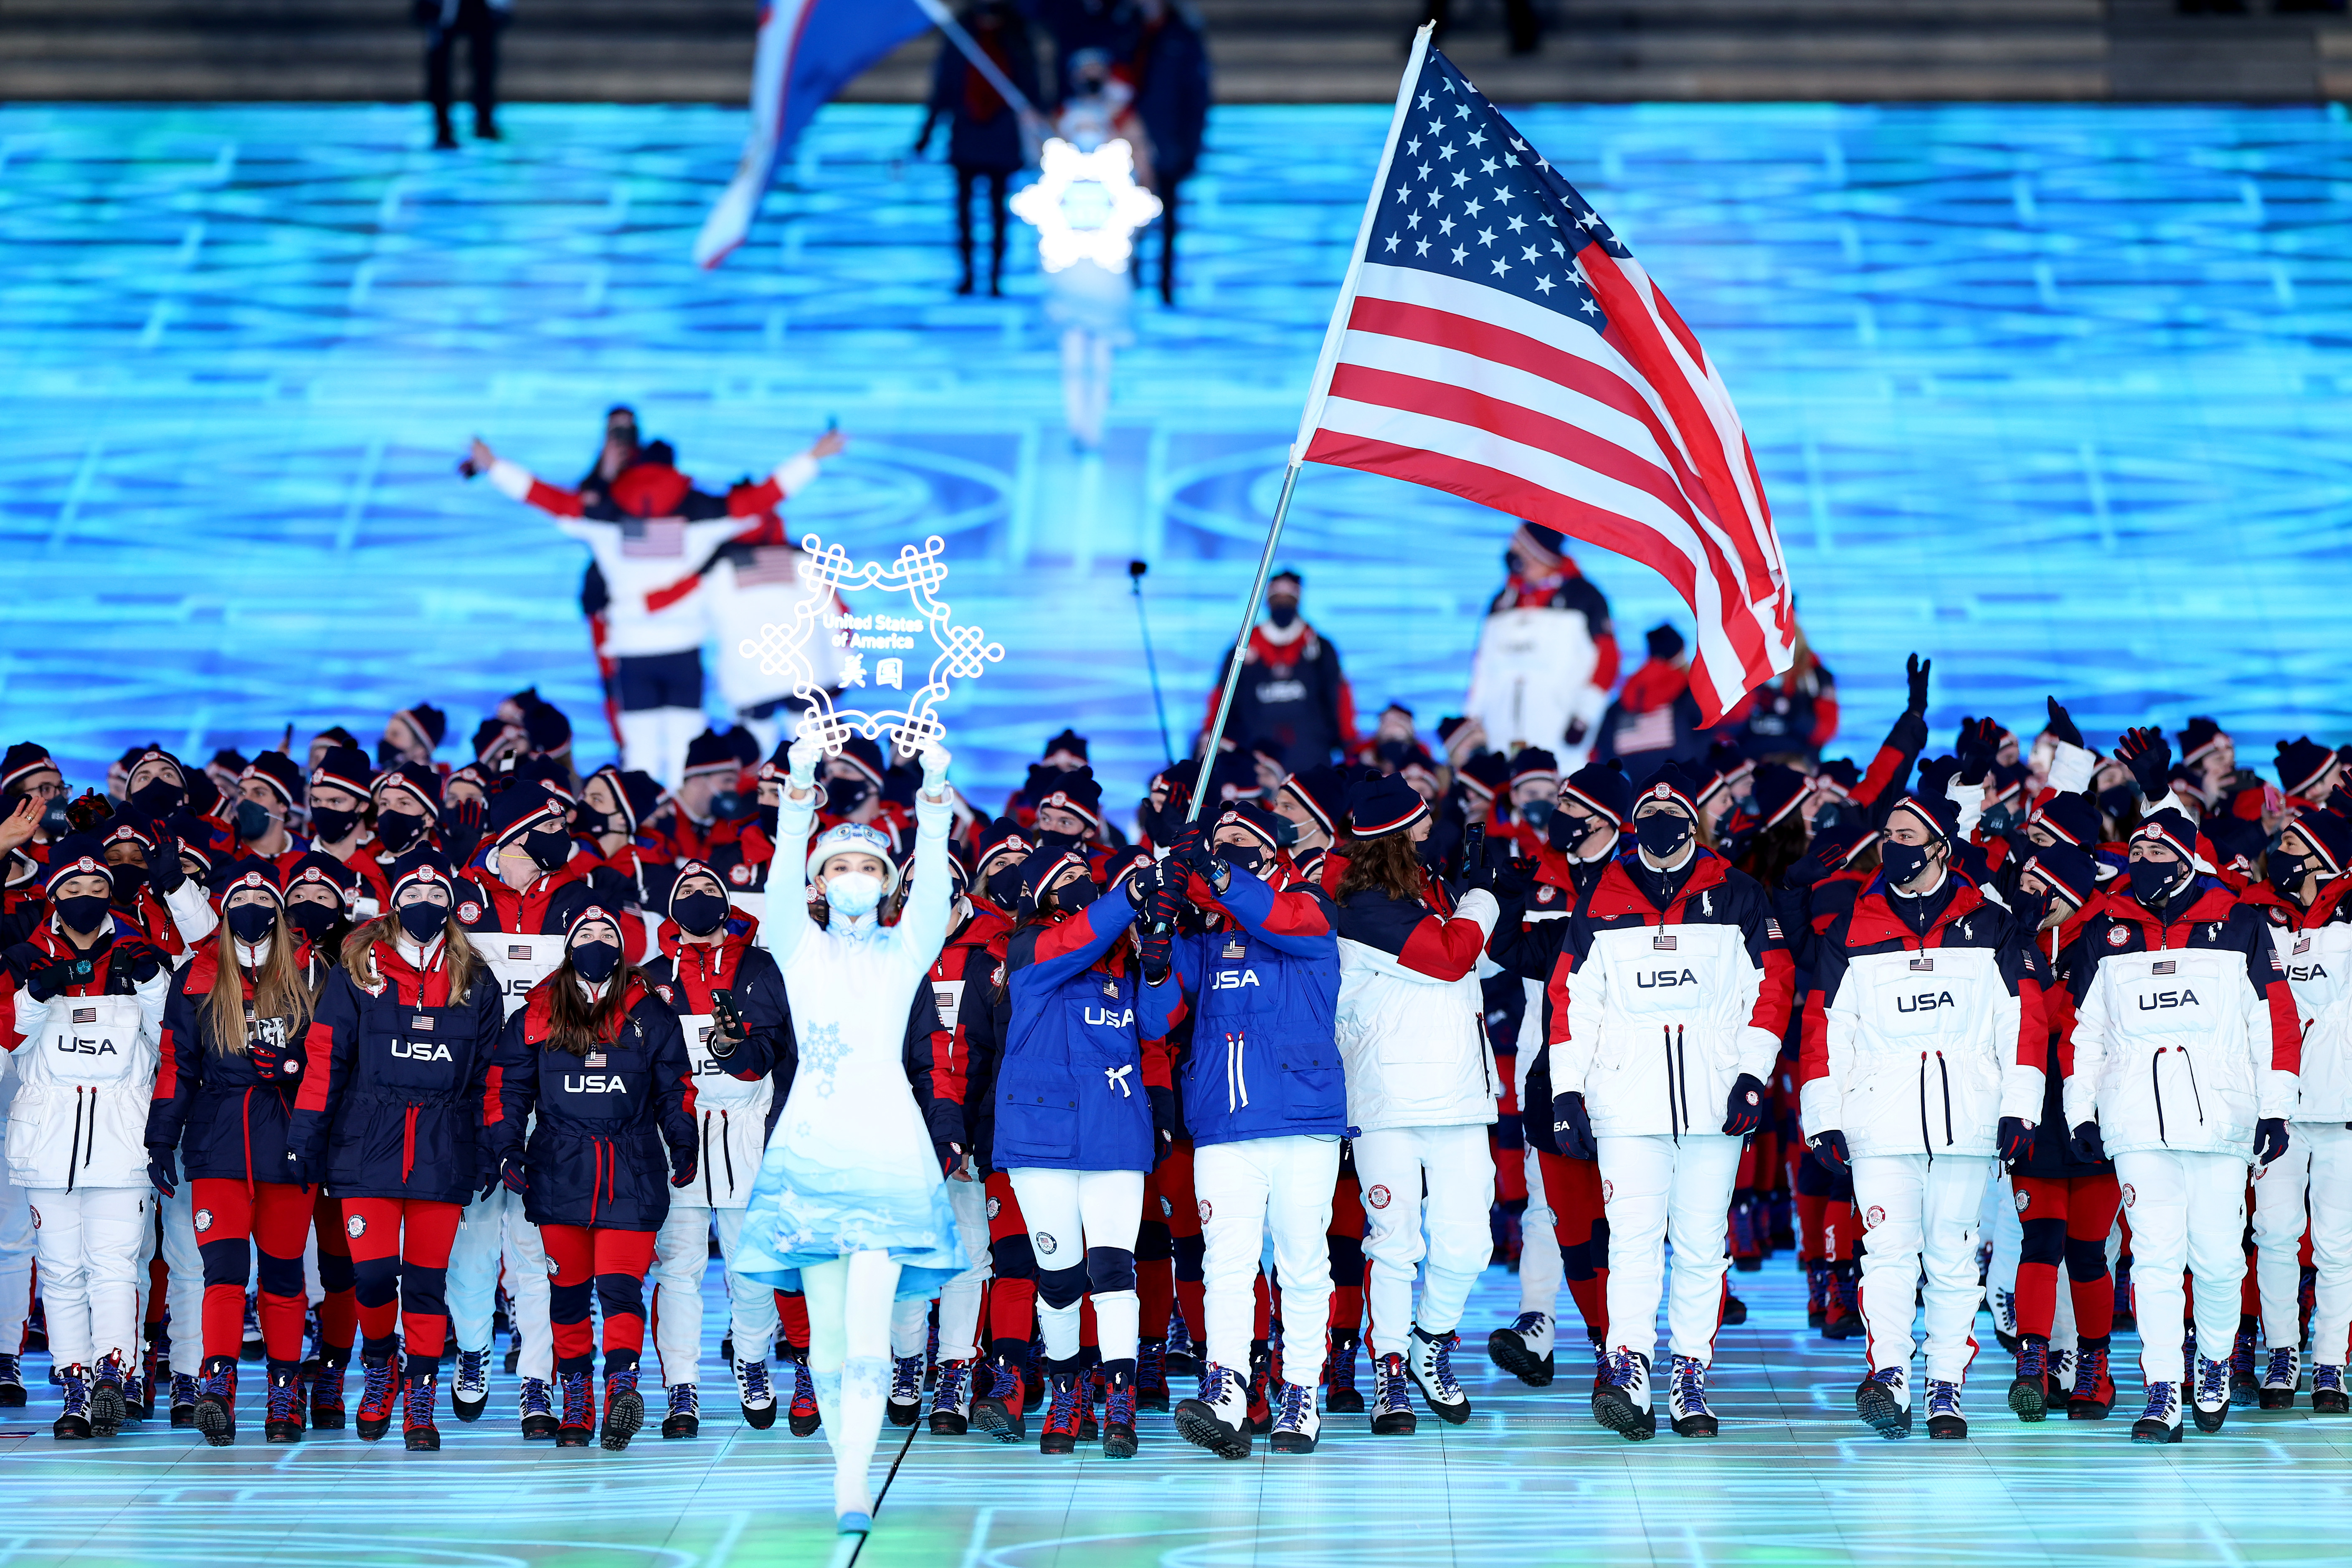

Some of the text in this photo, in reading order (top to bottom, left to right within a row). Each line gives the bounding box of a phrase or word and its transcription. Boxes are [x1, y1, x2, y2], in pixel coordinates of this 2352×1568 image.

[823, 613, 924, 632] United States
[831, 631, 914, 649] of America
[839, 653, 903, 690] 美国
[1155, 859, 1165, 887] USA
[1209, 970, 1260, 990] USA
[1637, 968, 1698, 988] USA
[1897, 991, 1954, 1013] USA
[2139, 989, 2200, 1011] USA
[1085, 1007, 1134, 1028] USA
[58, 1035, 117, 1056] USA
[391, 1039, 453, 1061] USA
[564, 1075, 627, 1094] USA
[1554, 1120, 1570, 1132] SA
